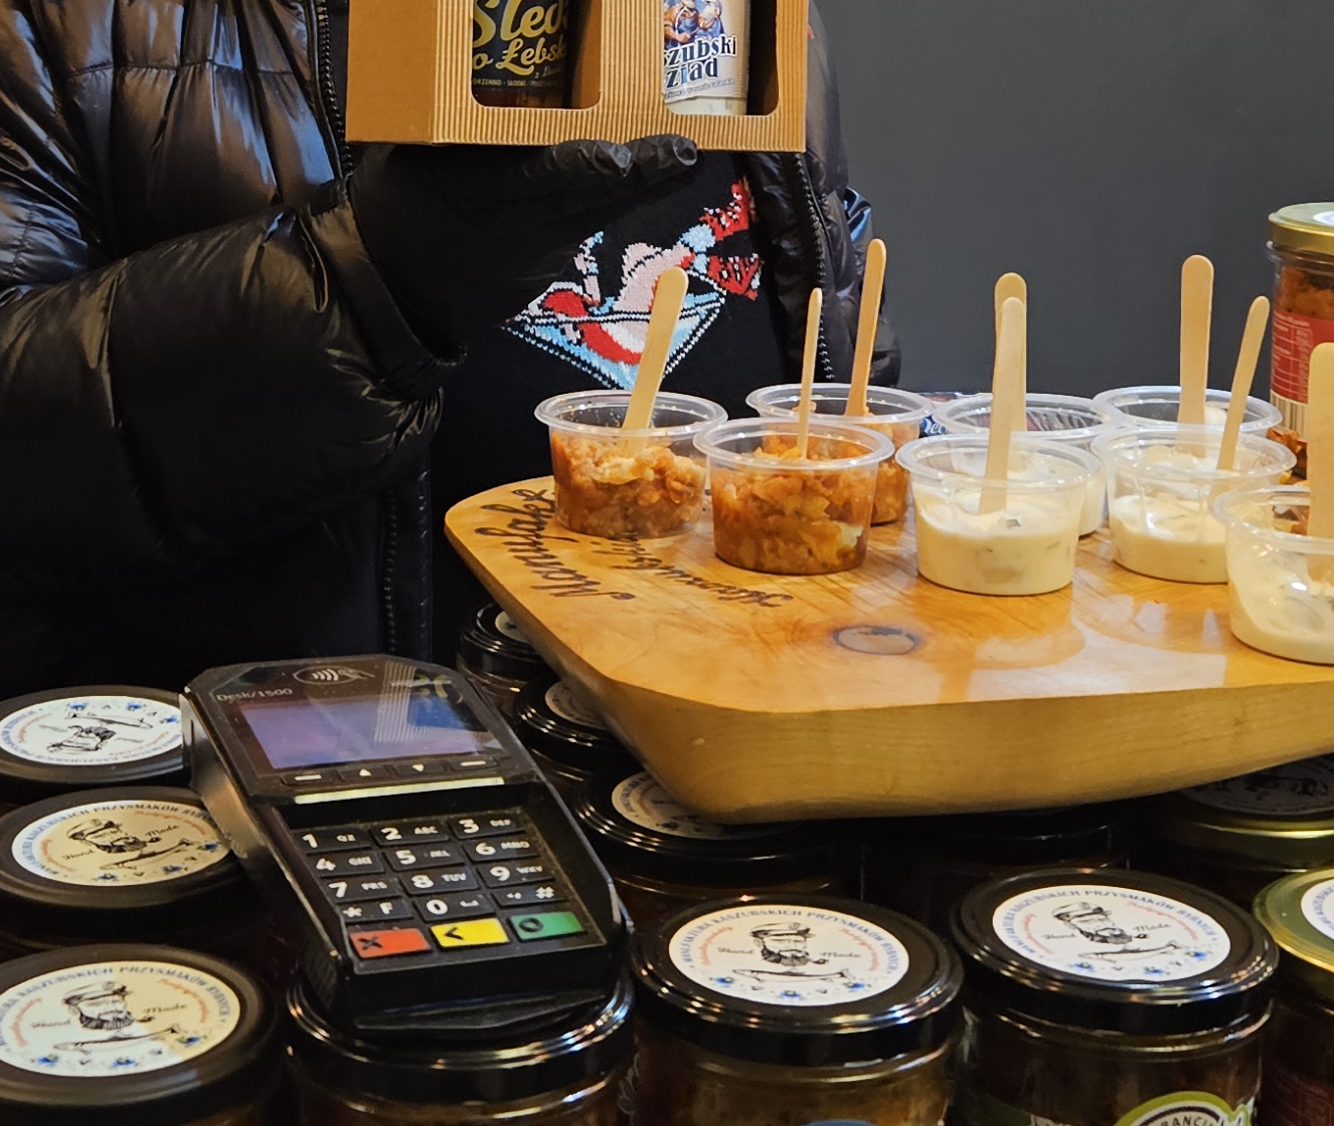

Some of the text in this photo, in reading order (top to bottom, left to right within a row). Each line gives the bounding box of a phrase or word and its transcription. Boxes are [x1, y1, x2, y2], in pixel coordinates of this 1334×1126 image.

[665, 57, 718, 88] ziad
[381, 826, 438, 841] 2 ABC
[459, 819, 480, 834] 3
[302, 833, 318, 849] 1
[475, 840, 530, 856] 6 MNO
[316, 857, 336, 872] 4
[396, 849, 417, 865] 5
[412, 872, 467, 889] 8 TUV
[490, 865, 511, 881] 9
[329, 880, 348, 898] 7
[378, 901, 394, 914] F
[426, 899, 448, 915] 0
[1085, 890, 1177, 912] PRZYSMAKÓW
[806, 911, 885, 942] PRZYSMAKÓW
